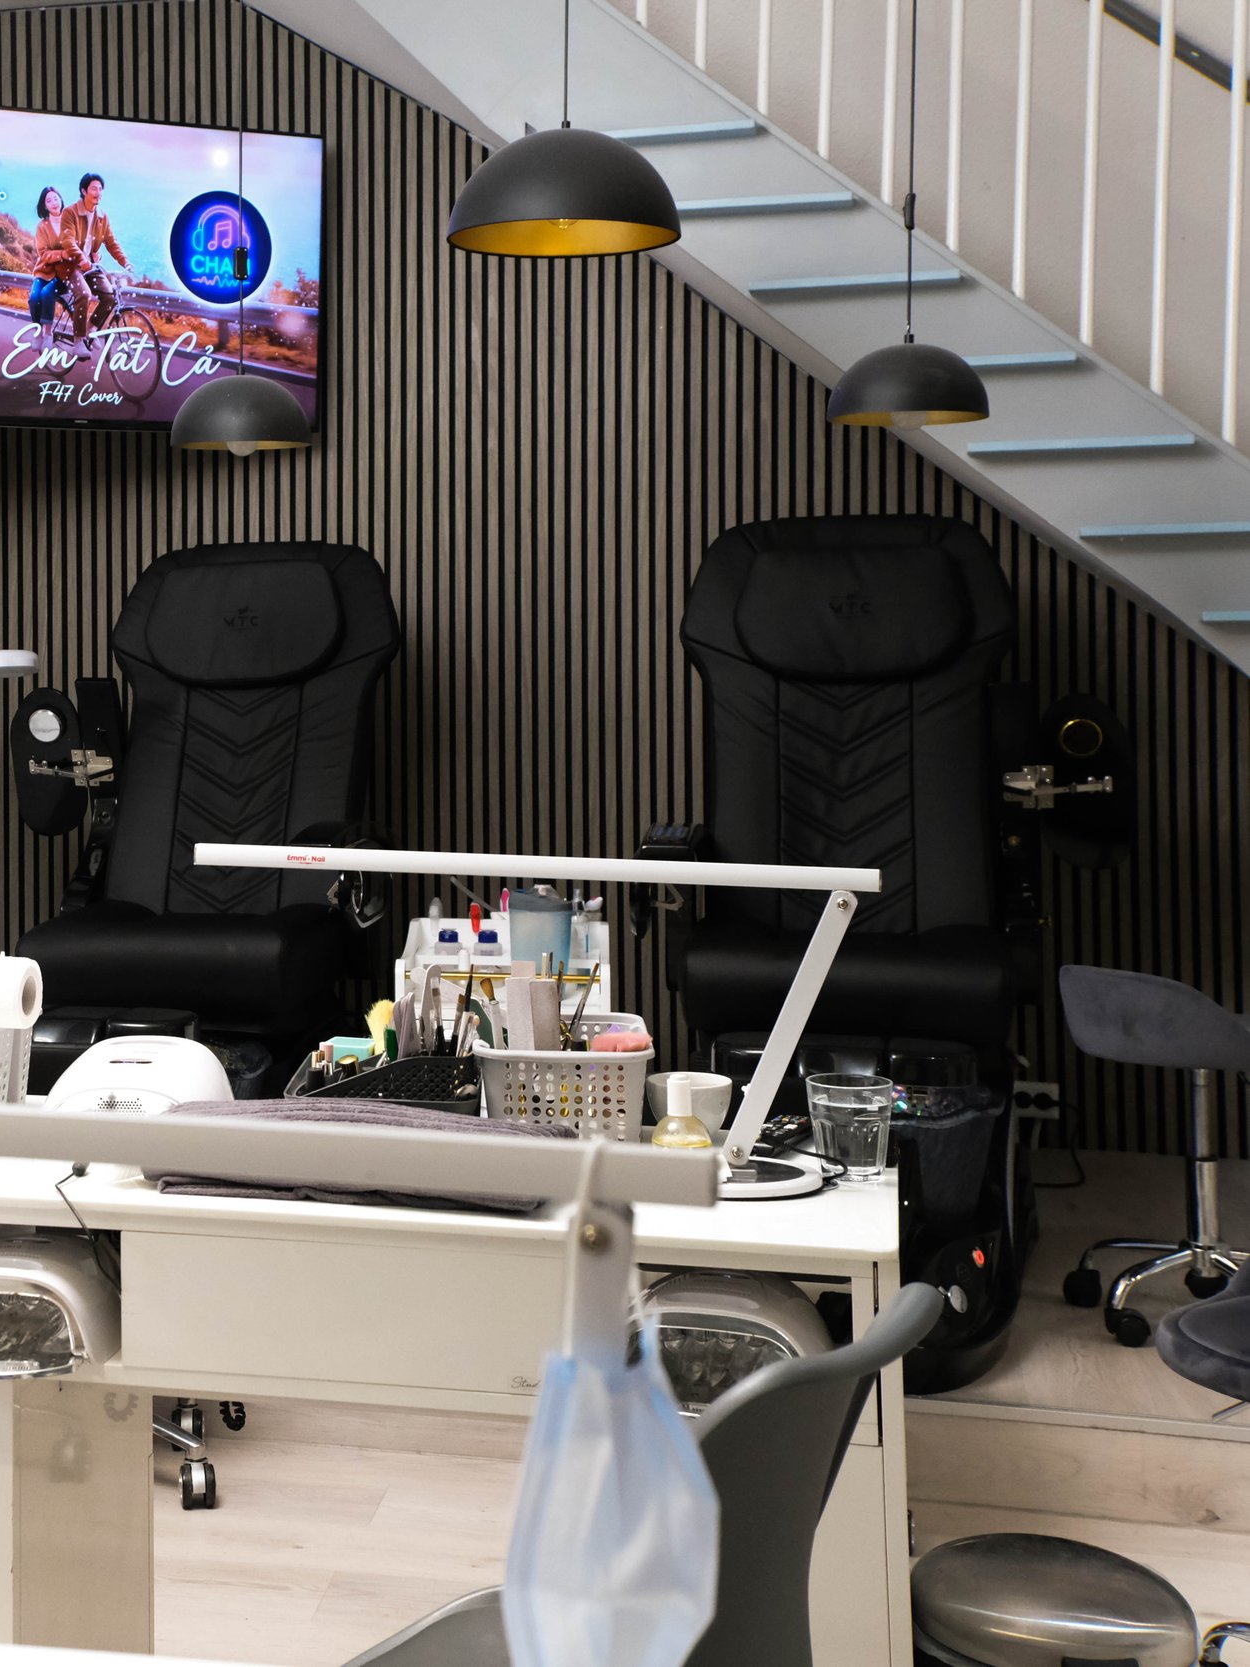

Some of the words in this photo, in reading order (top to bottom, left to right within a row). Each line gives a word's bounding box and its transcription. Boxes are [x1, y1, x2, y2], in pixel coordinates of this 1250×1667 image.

[1, 322, 78, 380] Em
[88, 326, 155, 382] Tất
[161, 330, 221, 387] Cả
[39, 380, 75, 404] F47
[78, 382, 123, 406] Cover
